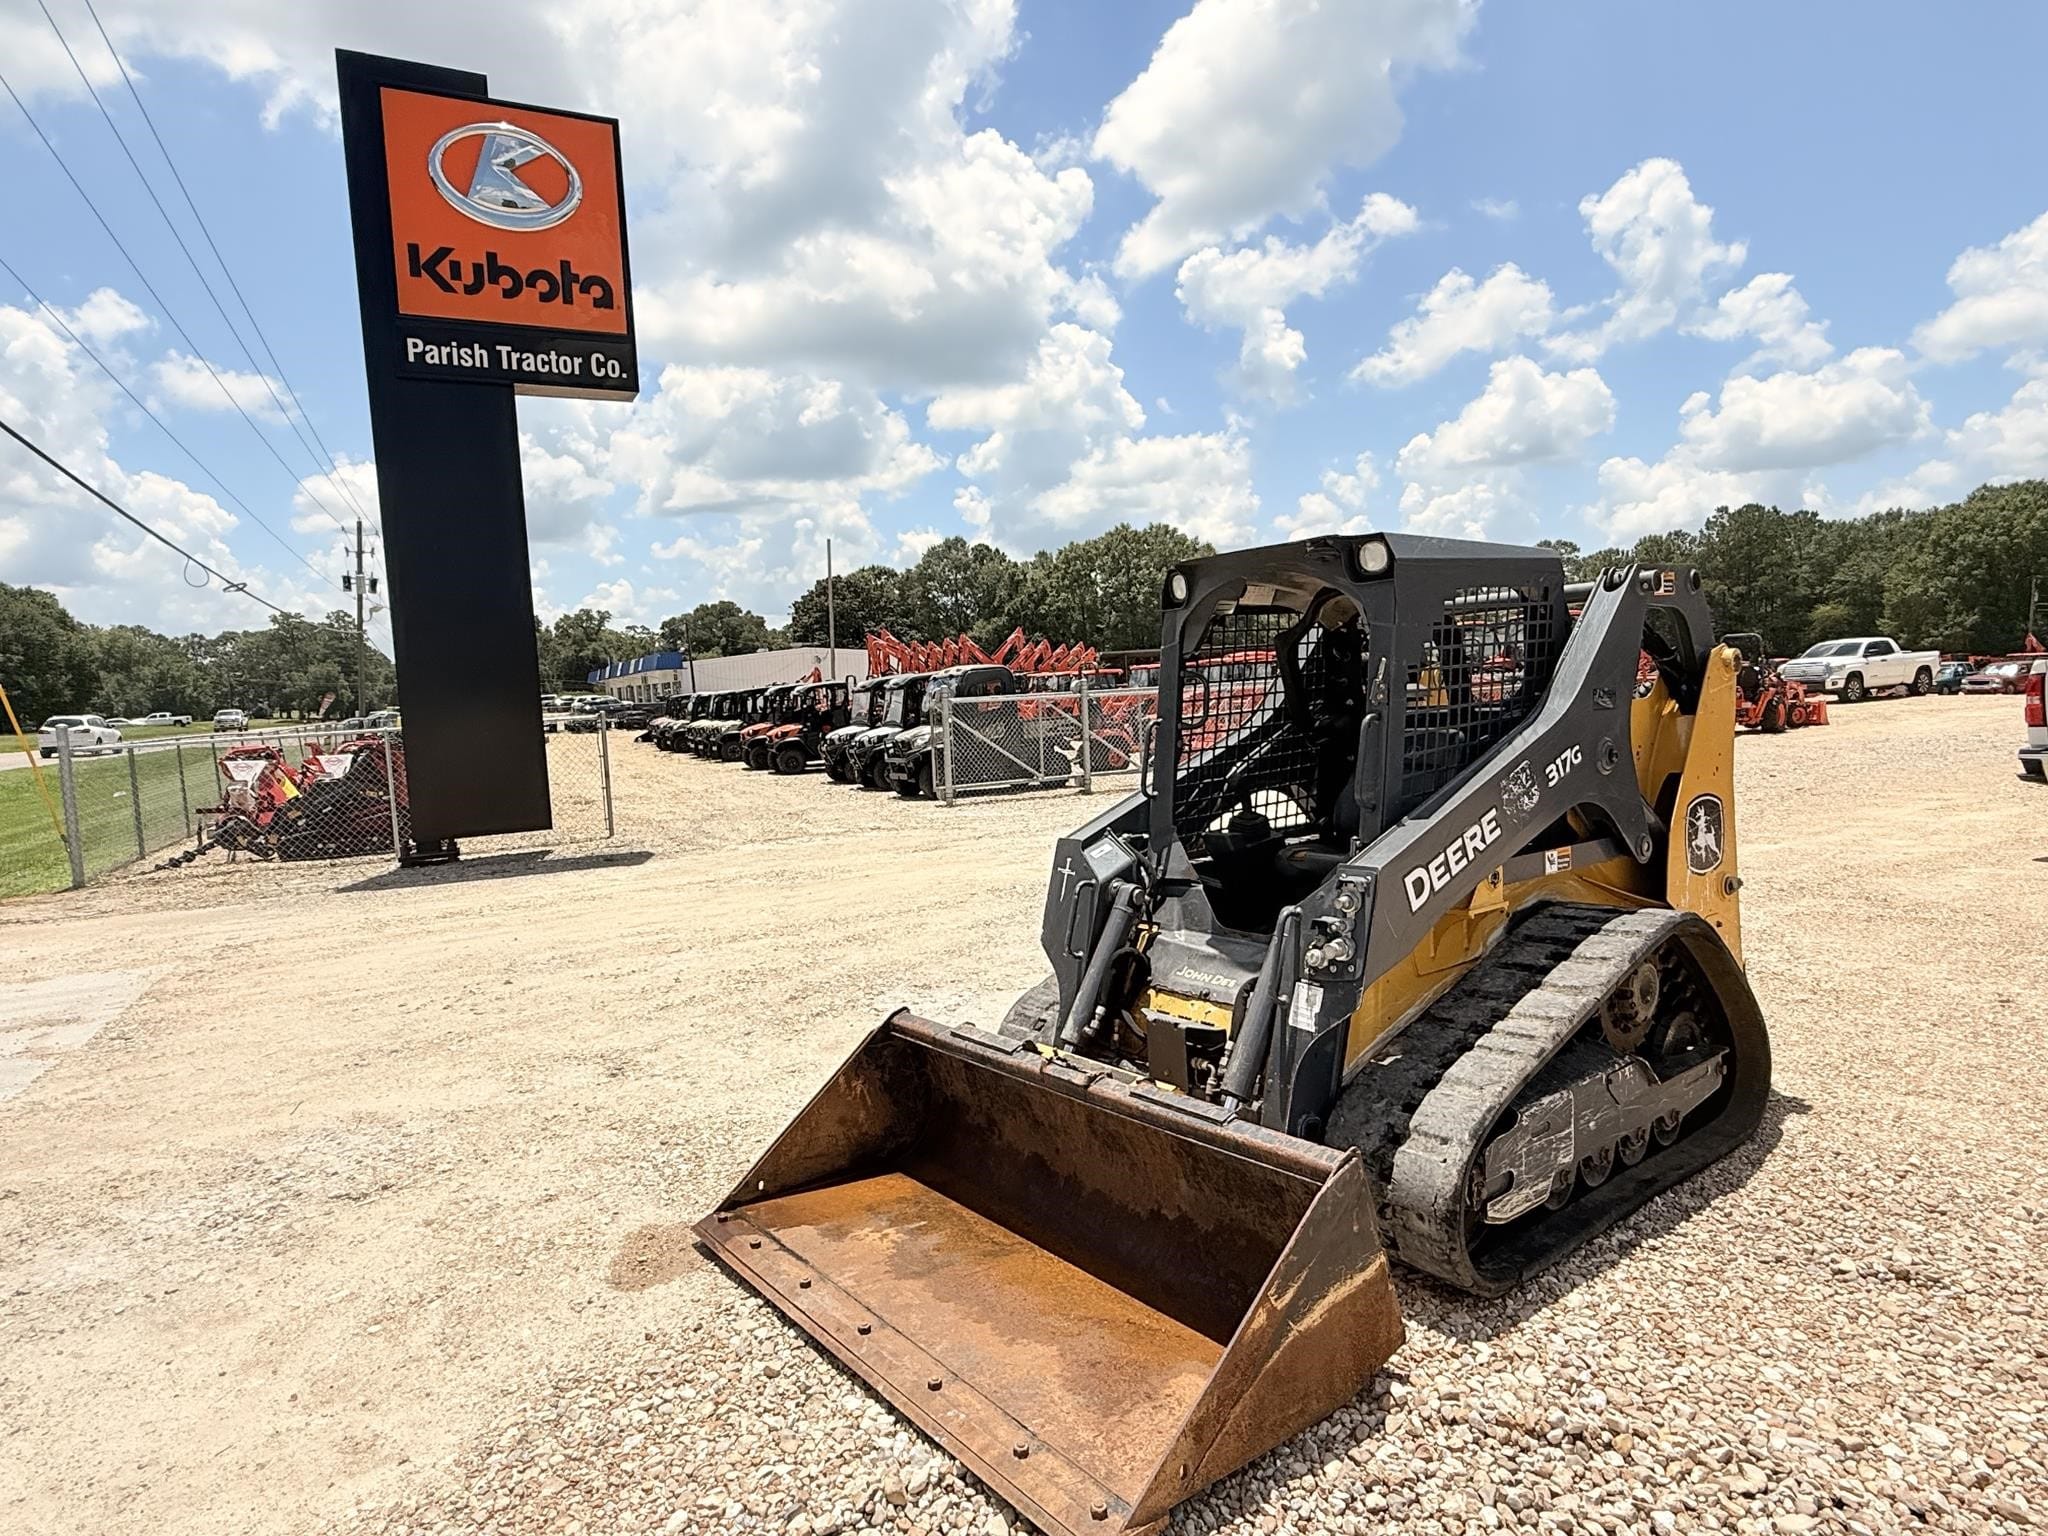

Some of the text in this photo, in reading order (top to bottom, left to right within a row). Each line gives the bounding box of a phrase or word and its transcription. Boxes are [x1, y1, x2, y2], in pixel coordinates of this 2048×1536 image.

[406, 242, 614, 310] Kubota
[406, 337, 628, 378] Parish Tractor Co.
[1544, 743, 1583, 788] 317G
[1403, 807, 1502, 913] DEERE
[1176, 966, 1212, 982] JOHN
